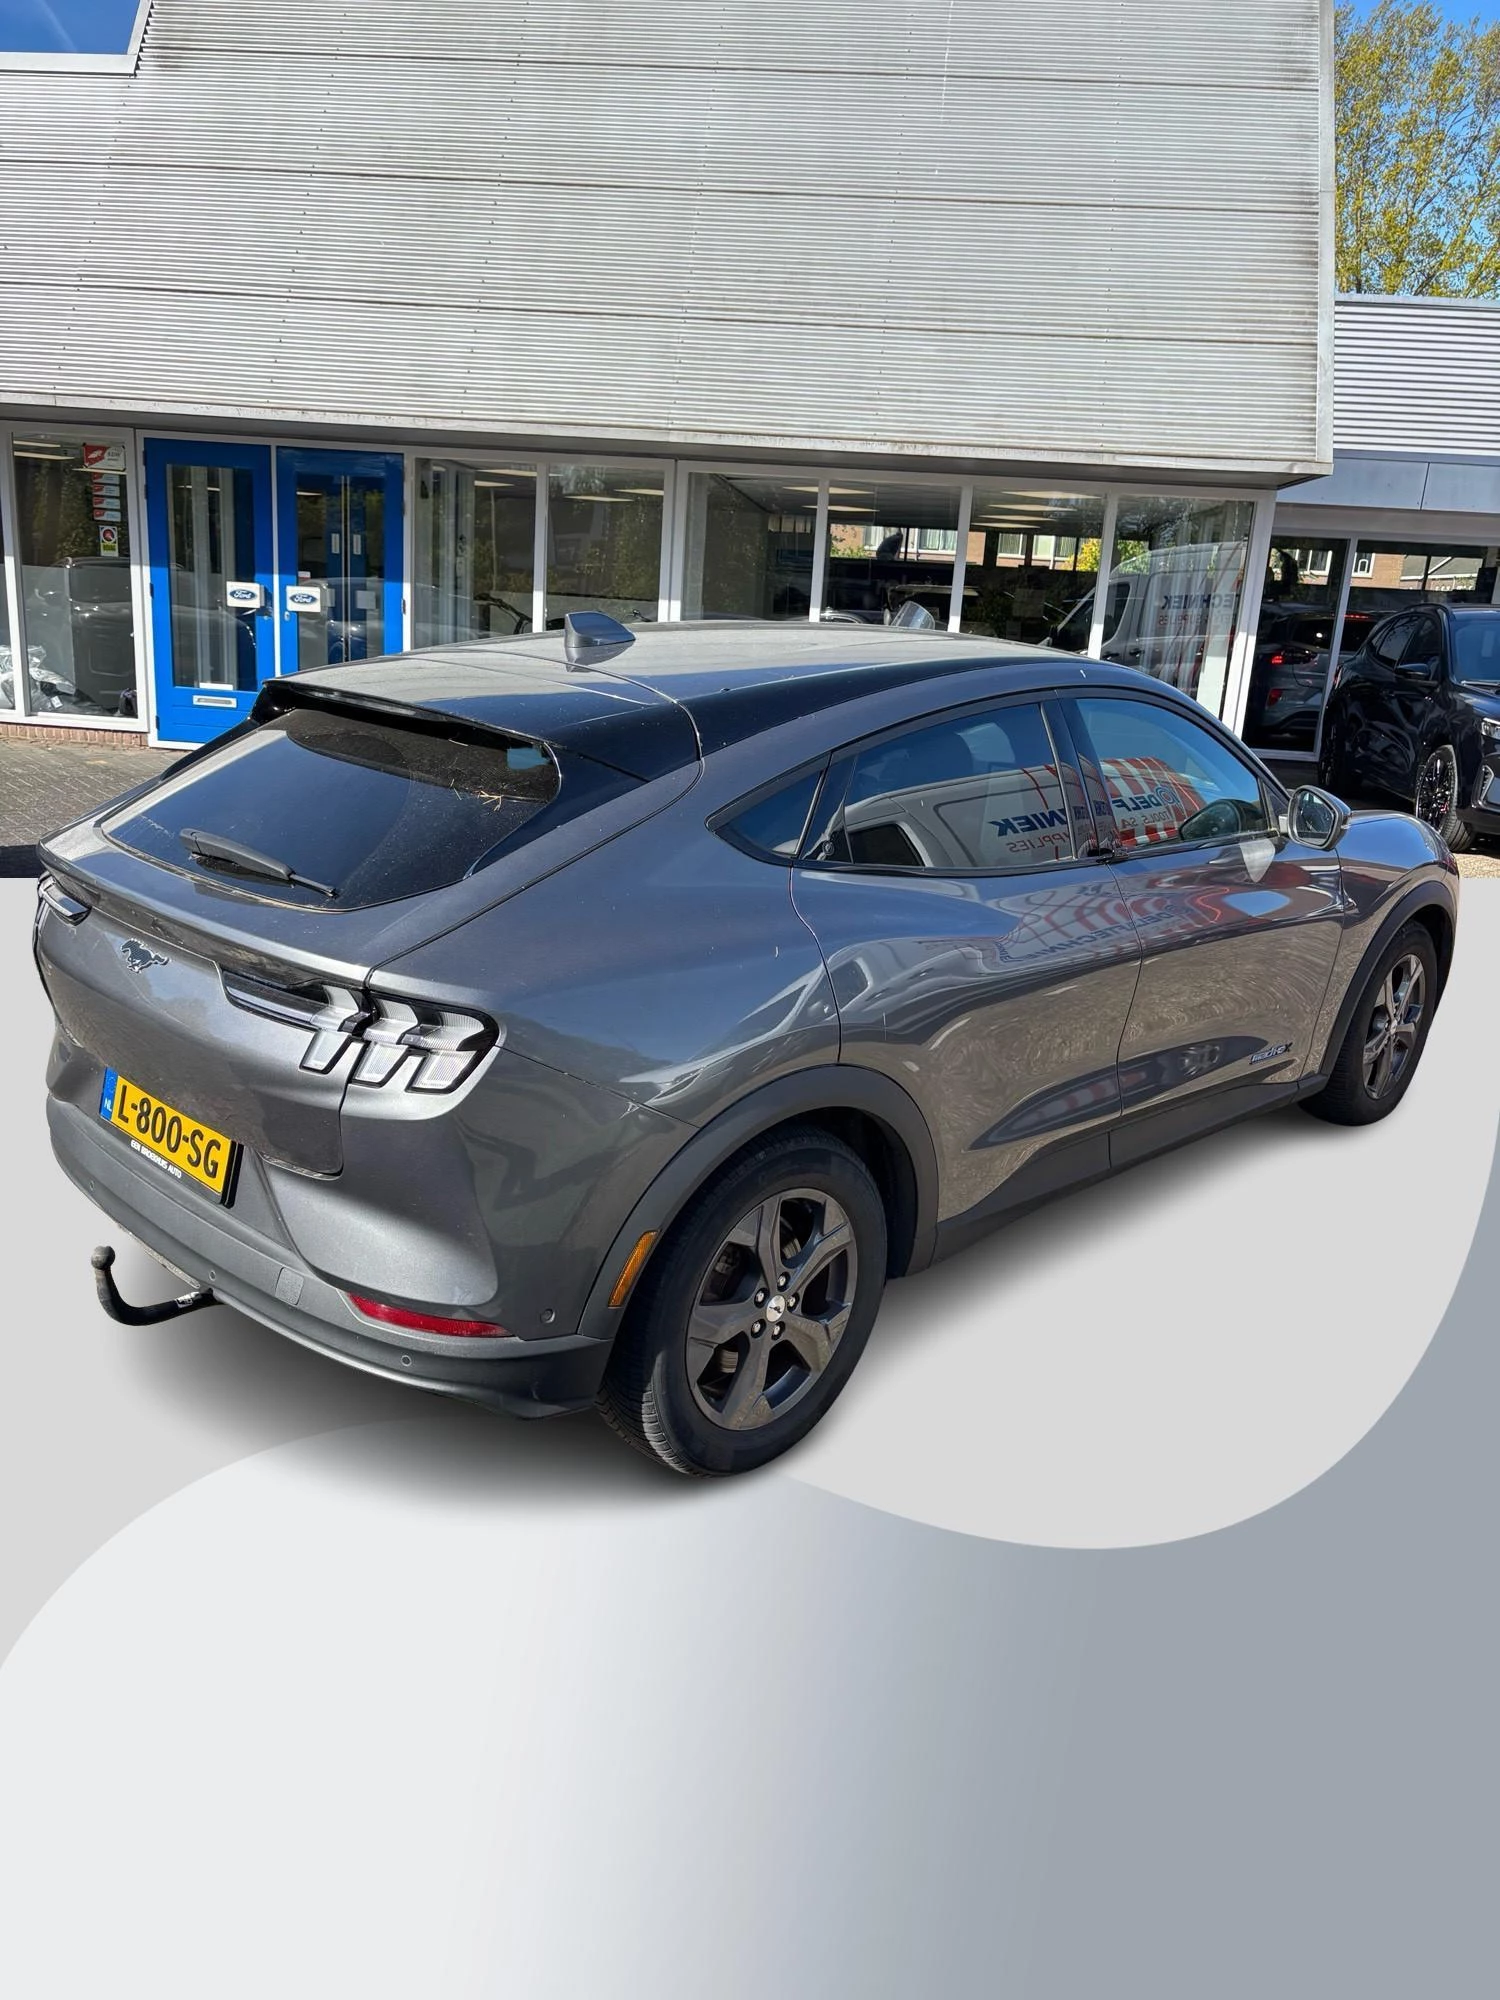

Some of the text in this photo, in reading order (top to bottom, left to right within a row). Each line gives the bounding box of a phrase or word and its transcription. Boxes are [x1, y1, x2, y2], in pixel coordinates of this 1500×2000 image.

[103, 1097, 113, 1112] NL
[117, 1084, 221, 1179] L-800-SG
[167, 1163, 182, 1179] AUTO
